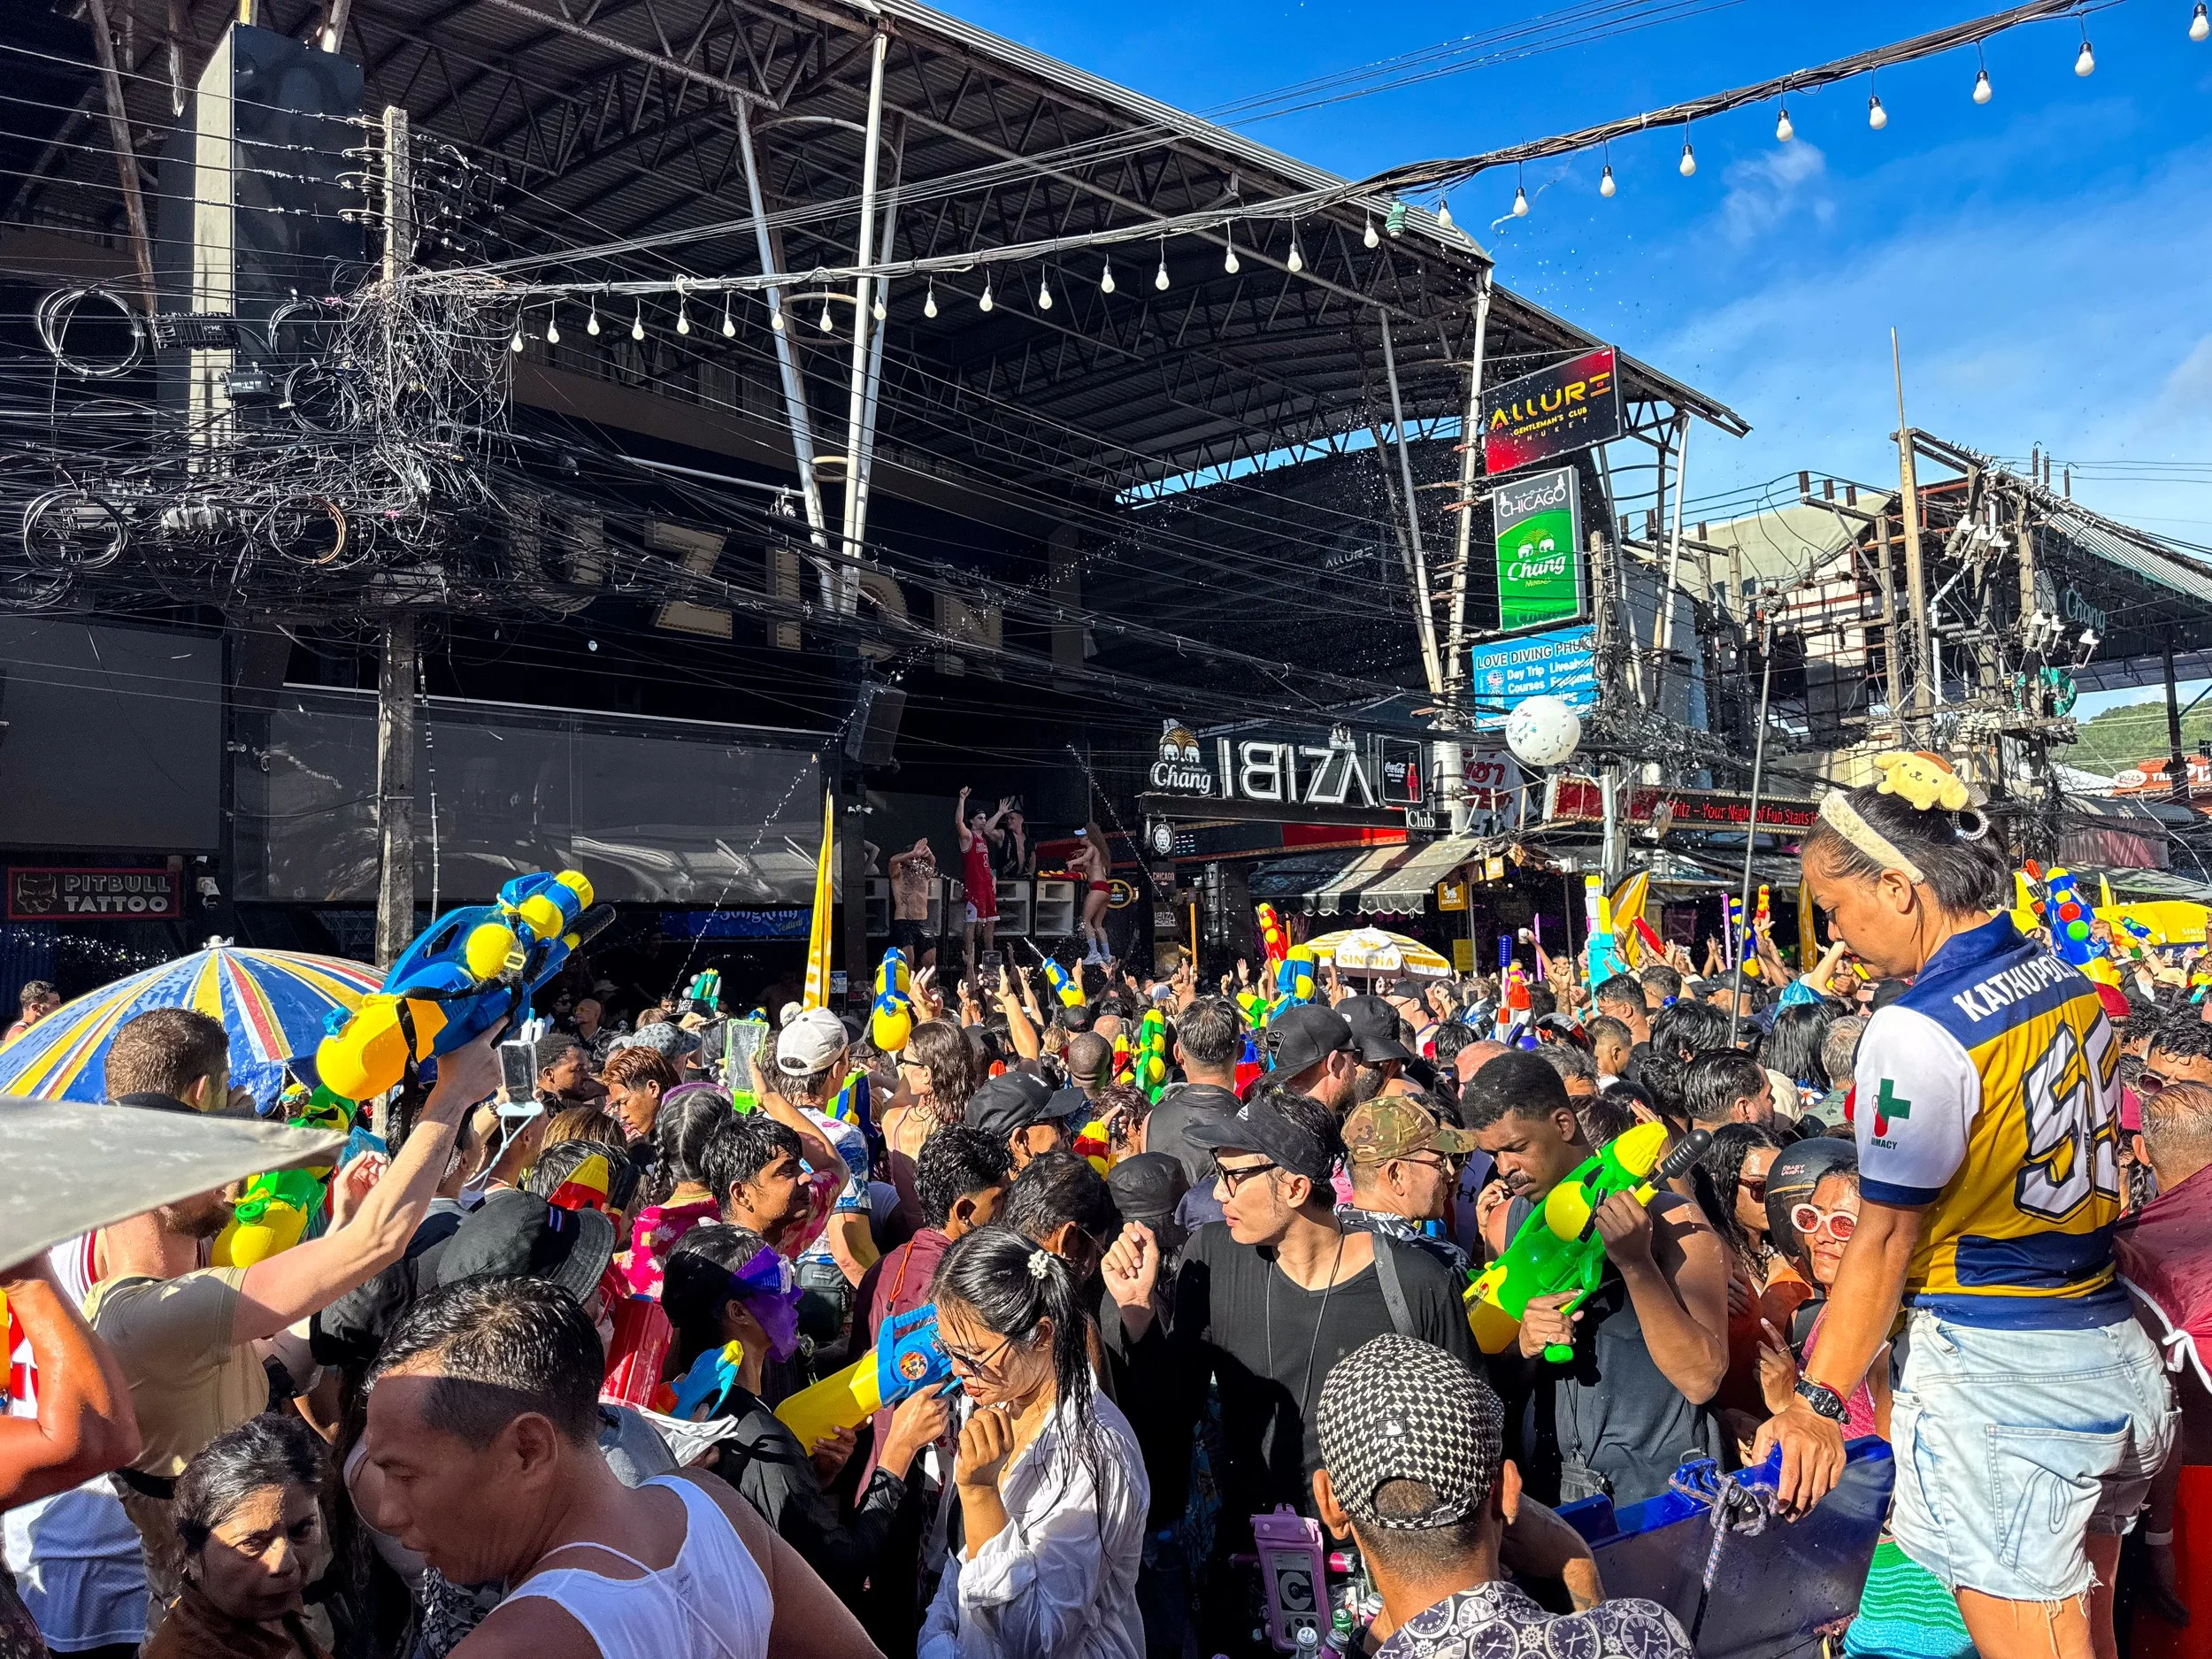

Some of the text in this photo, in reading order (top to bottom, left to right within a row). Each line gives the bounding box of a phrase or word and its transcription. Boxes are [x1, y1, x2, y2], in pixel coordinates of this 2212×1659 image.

[1490, 372, 1611, 431] ALLURE
[1513, 406, 1587, 435] GENTLEMAN'S CLUB
[1514, 417, 1587, 446] PHUKET
[1500, 488, 1566, 518] CHICAGO
[1507, 556, 1567, 581] Chang
[1477, 653, 1508, 669] LOVE
[1511, 646, 1553, 664] DIVING
[1507, 665, 1545, 680] Day Trip
[1507, 680, 1546, 695] Courses
[1151, 762, 1211, 795] Chang
[1217, 737, 1376, 807] IBIZA
[1408, 810, 1435, 828] Club
[1702, 803, 1726, 819] Your
[1728, 803, 1751, 823] Nigh
[1767, 807, 1783, 824] Fun
[1786, 808, 1809, 826] Starts
[64, 874, 171, 893] PITBULL
[64, 895, 169, 912] TATTOO
[1340, 954, 1395, 967] SINGHA
